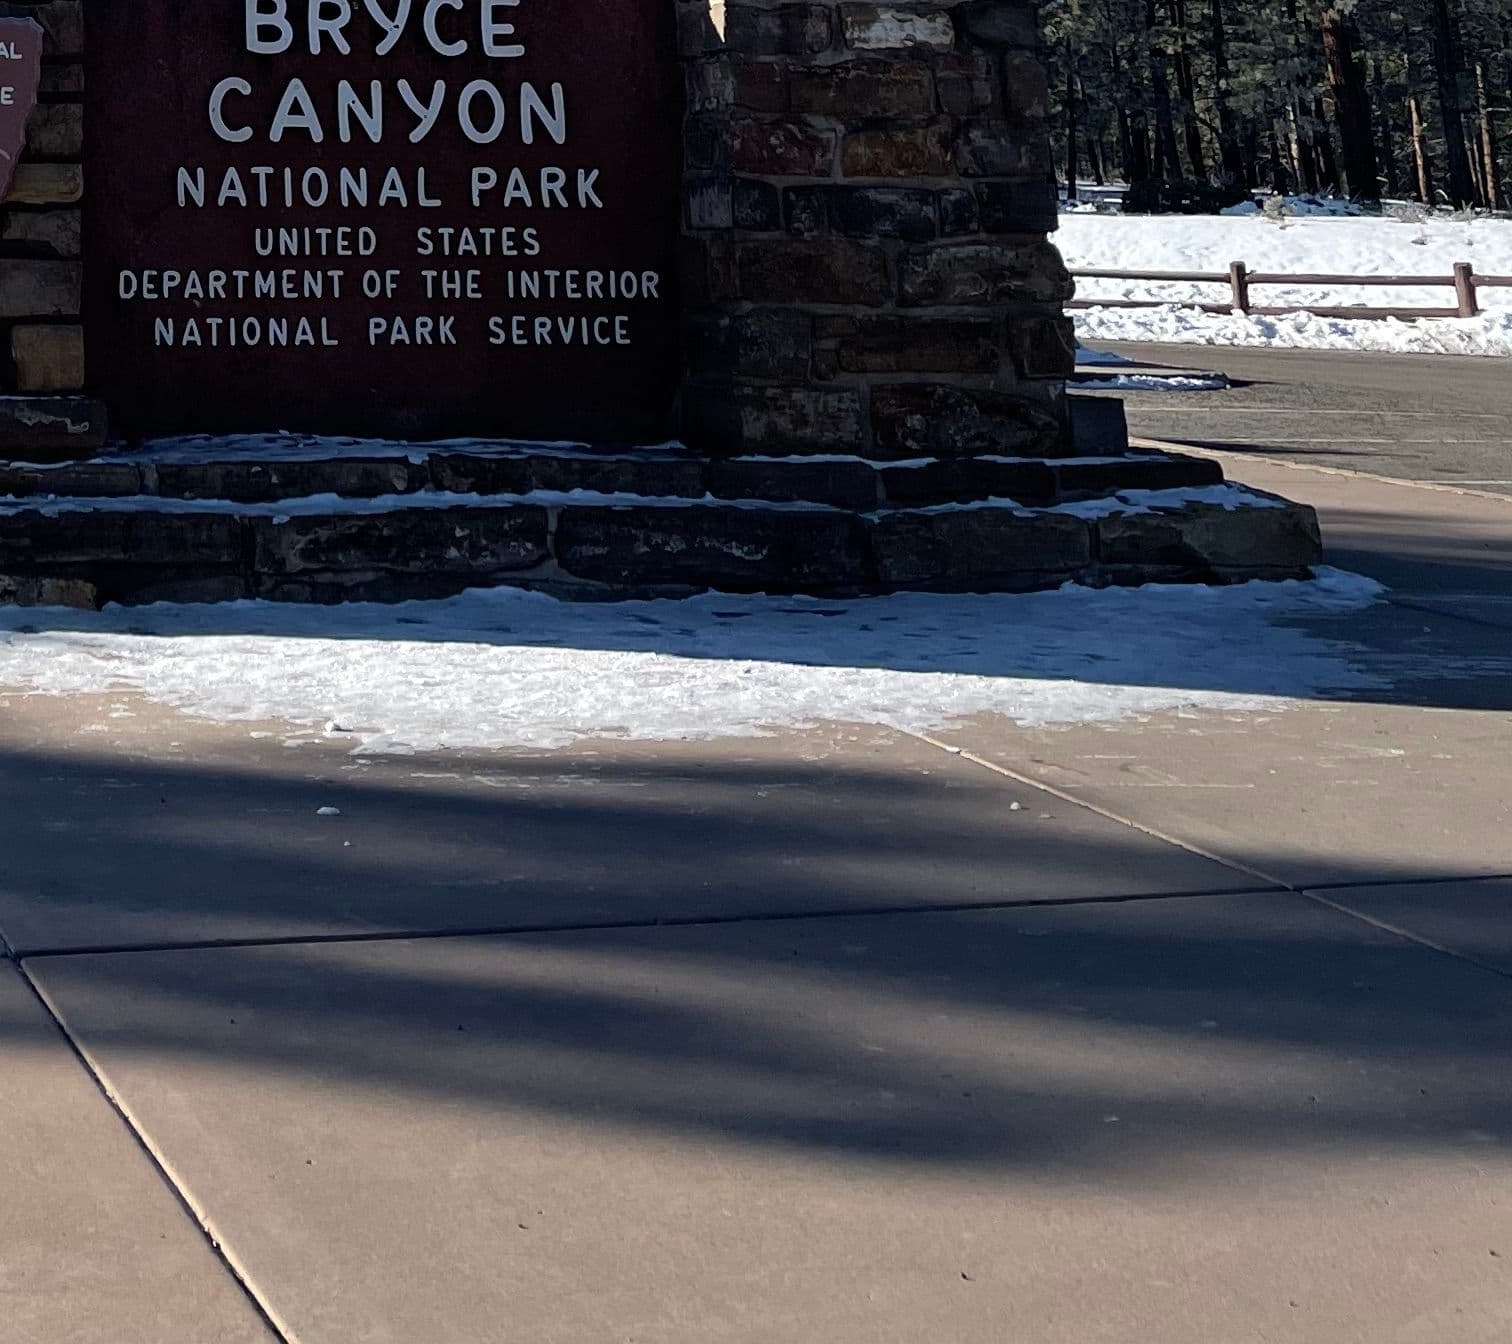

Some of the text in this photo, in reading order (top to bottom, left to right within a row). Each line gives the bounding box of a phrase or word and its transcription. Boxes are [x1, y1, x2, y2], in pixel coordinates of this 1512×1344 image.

[208, 76, 566, 145] CANYON
[177, 166, 603, 209] NATIONAL PARK
[255, 226, 541, 256] UNITED STATES
[119, 269, 661, 300] DEPARTMENT OF THE INTERIOR
[154, 315, 632, 347] NATIONAL PARK SERVICE
